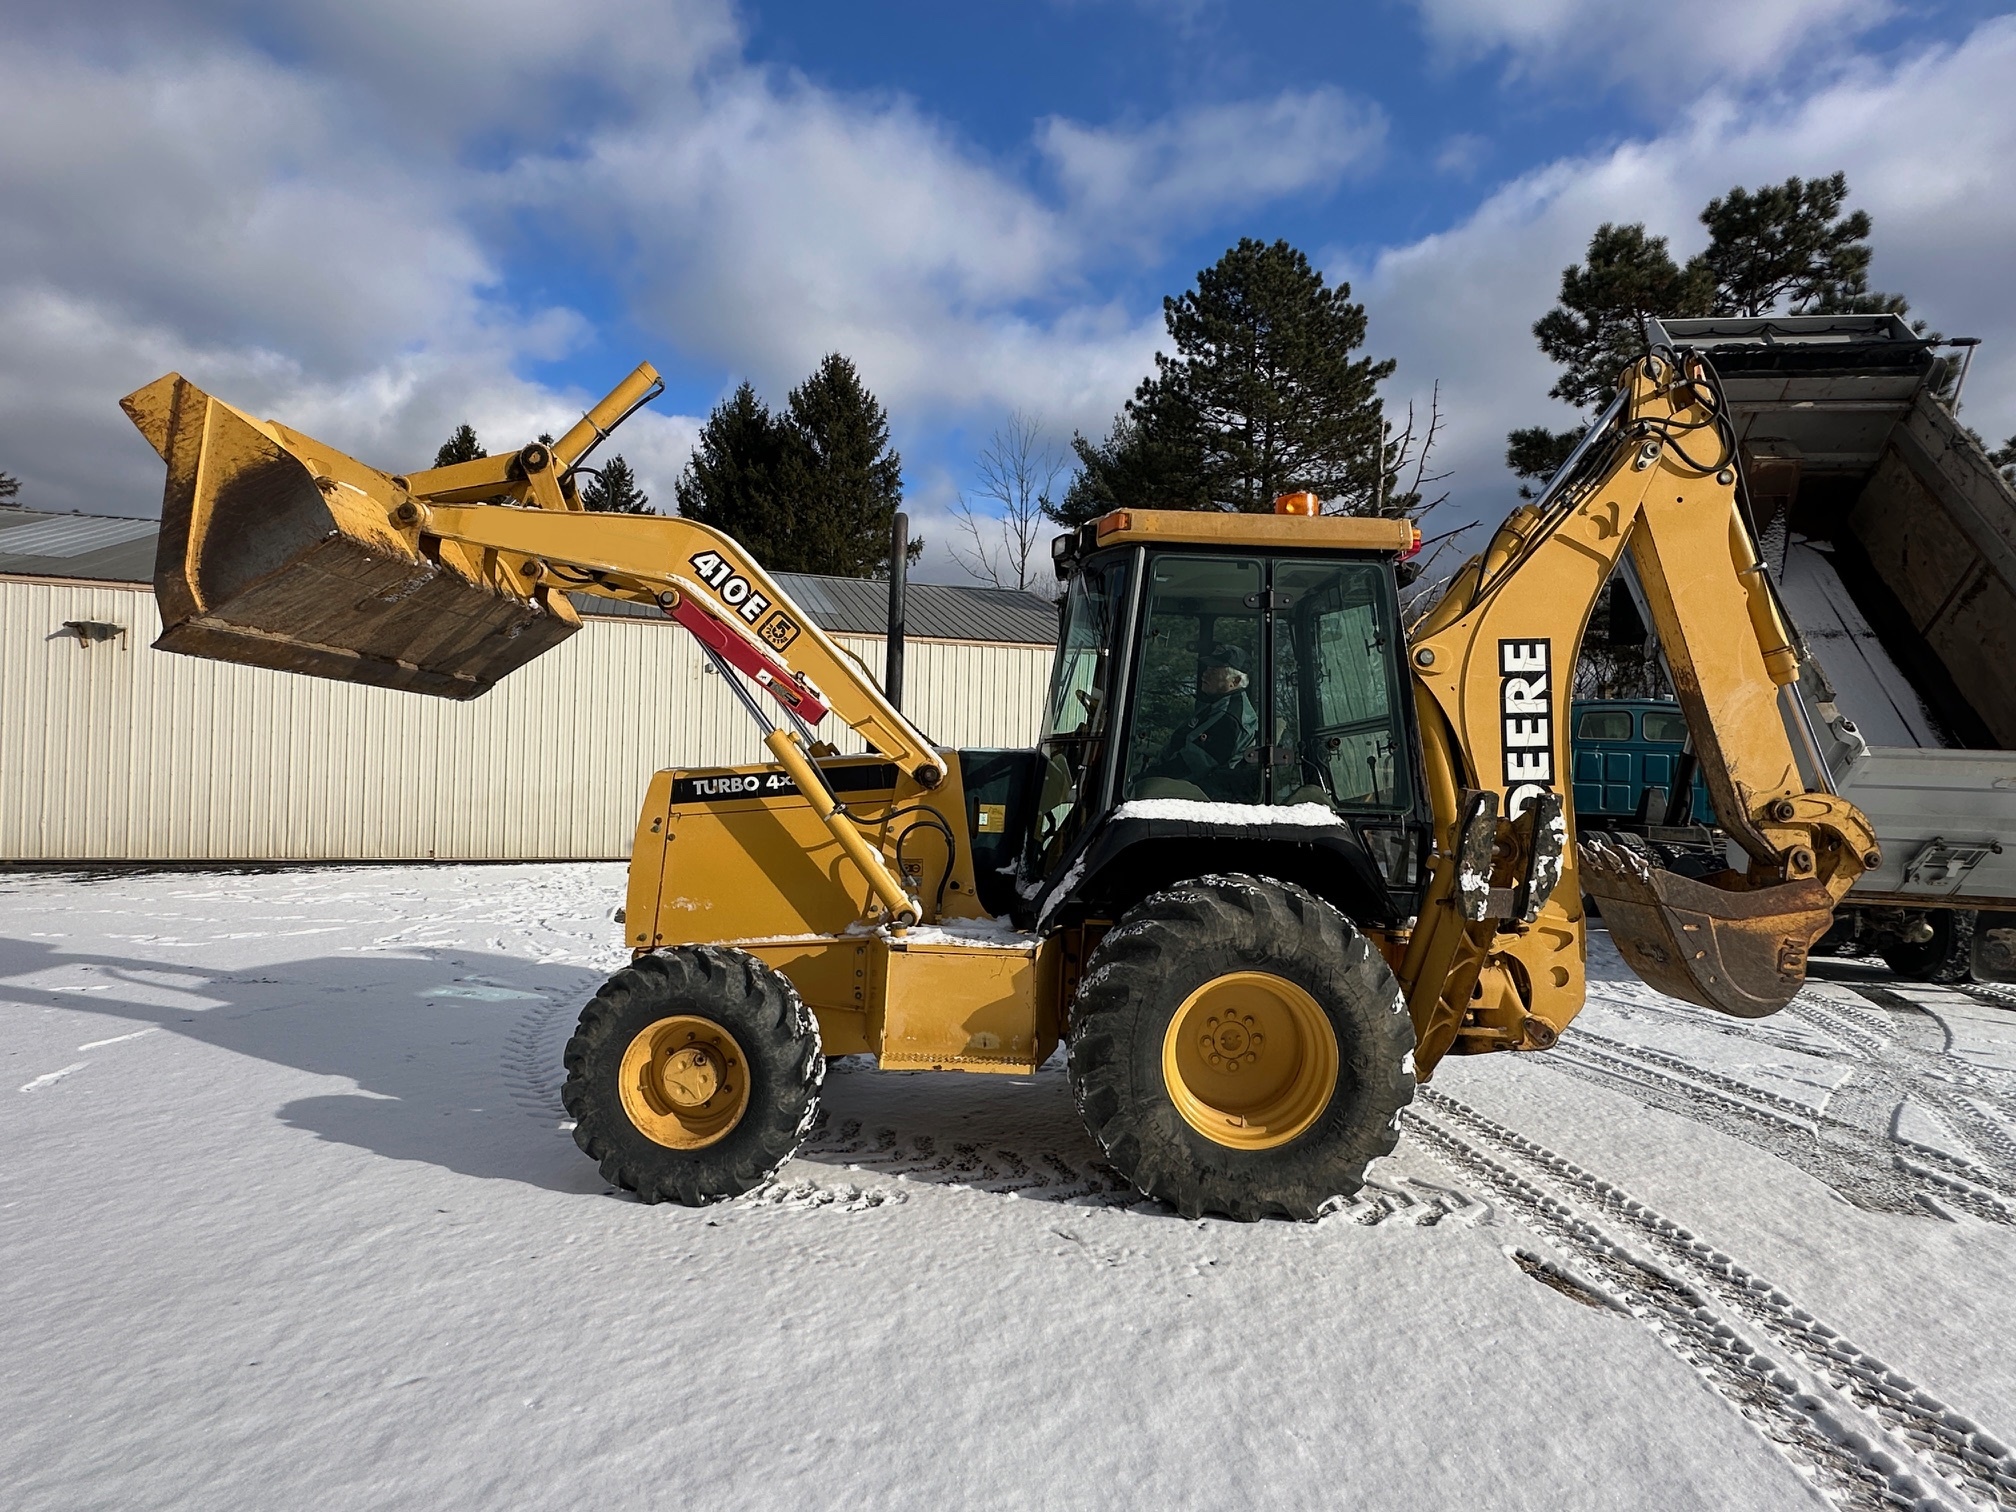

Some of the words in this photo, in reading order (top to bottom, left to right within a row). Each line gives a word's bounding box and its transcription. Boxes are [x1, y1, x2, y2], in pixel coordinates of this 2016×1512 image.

[691, 551, 769, 622] 410E
[692, 775, 760, 796] TURBO
[765, 774, 797, 790] 4x
